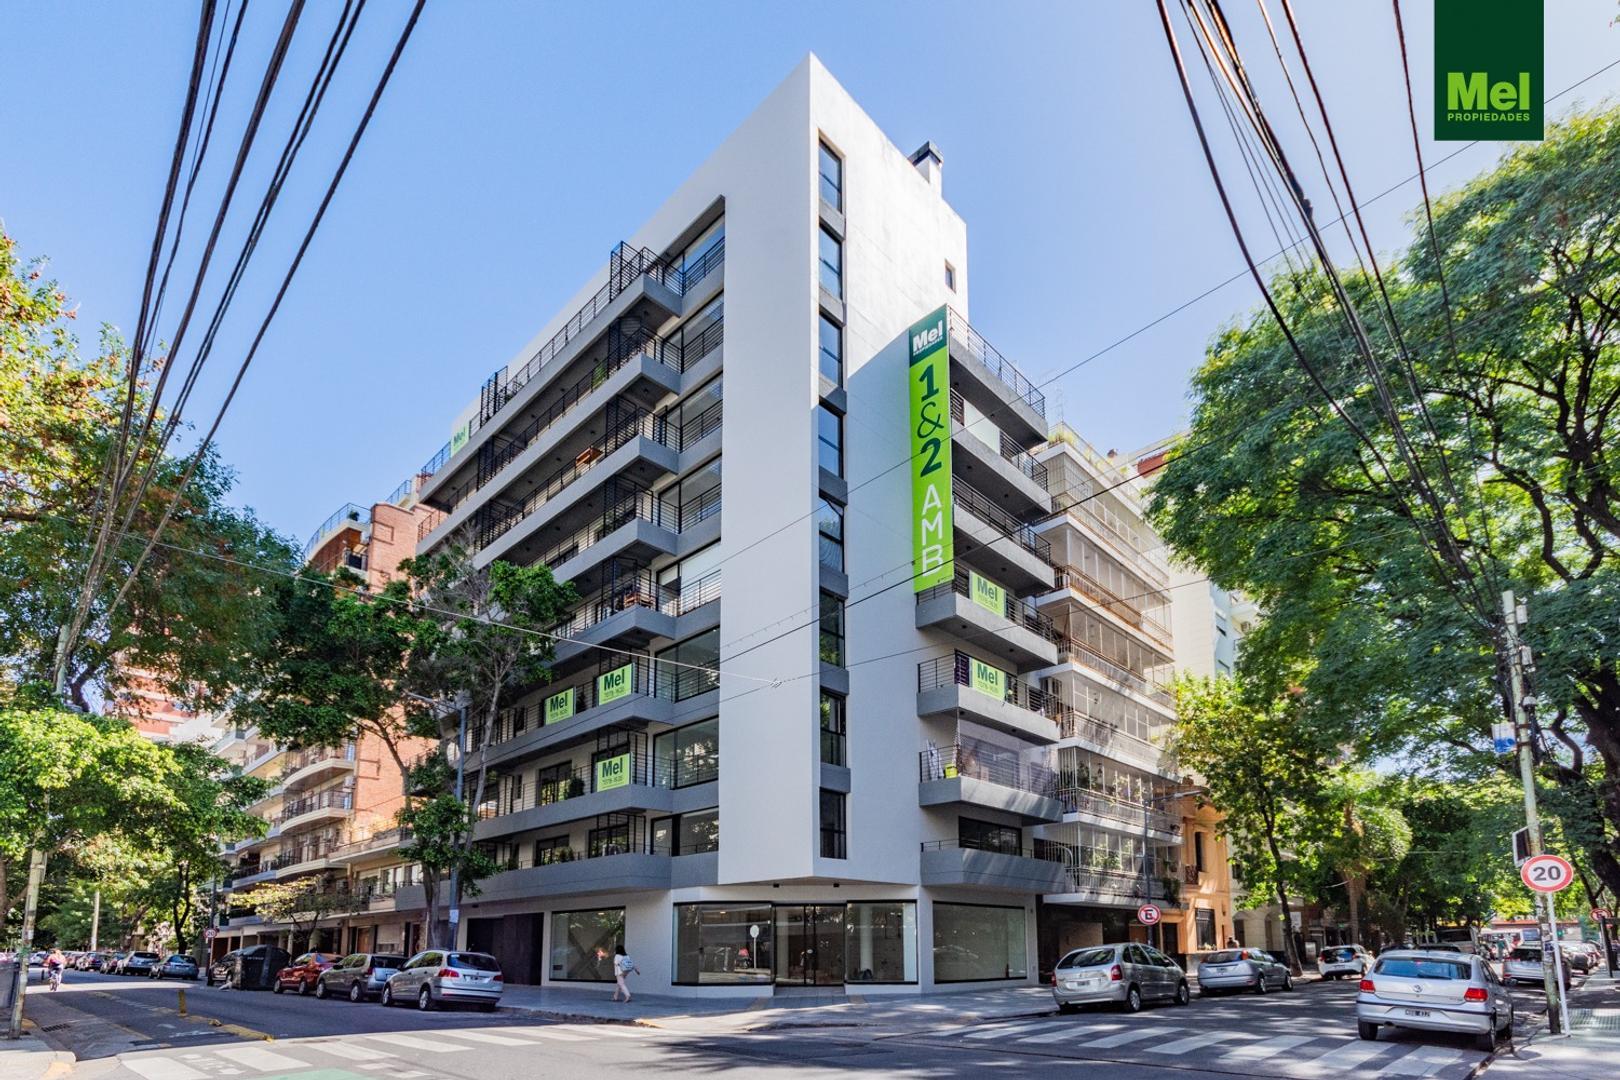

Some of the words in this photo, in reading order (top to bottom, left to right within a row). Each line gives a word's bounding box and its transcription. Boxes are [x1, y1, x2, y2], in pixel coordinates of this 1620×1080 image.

[913, 319, 943, 352] Mel
[919, 363, 940, 402] 1
[917, 401, 944, 438] &
[920, 437, 942, 478] 2
[977, 576, 998, 602] Mel
[604, 668, 625, 691] Mel
[977, 663, 998, 686] Mel
[550, 692, 568, 712] Mel
[602, 757, 623, 778] Mel
[1533, 865, 1561, 881] 20
